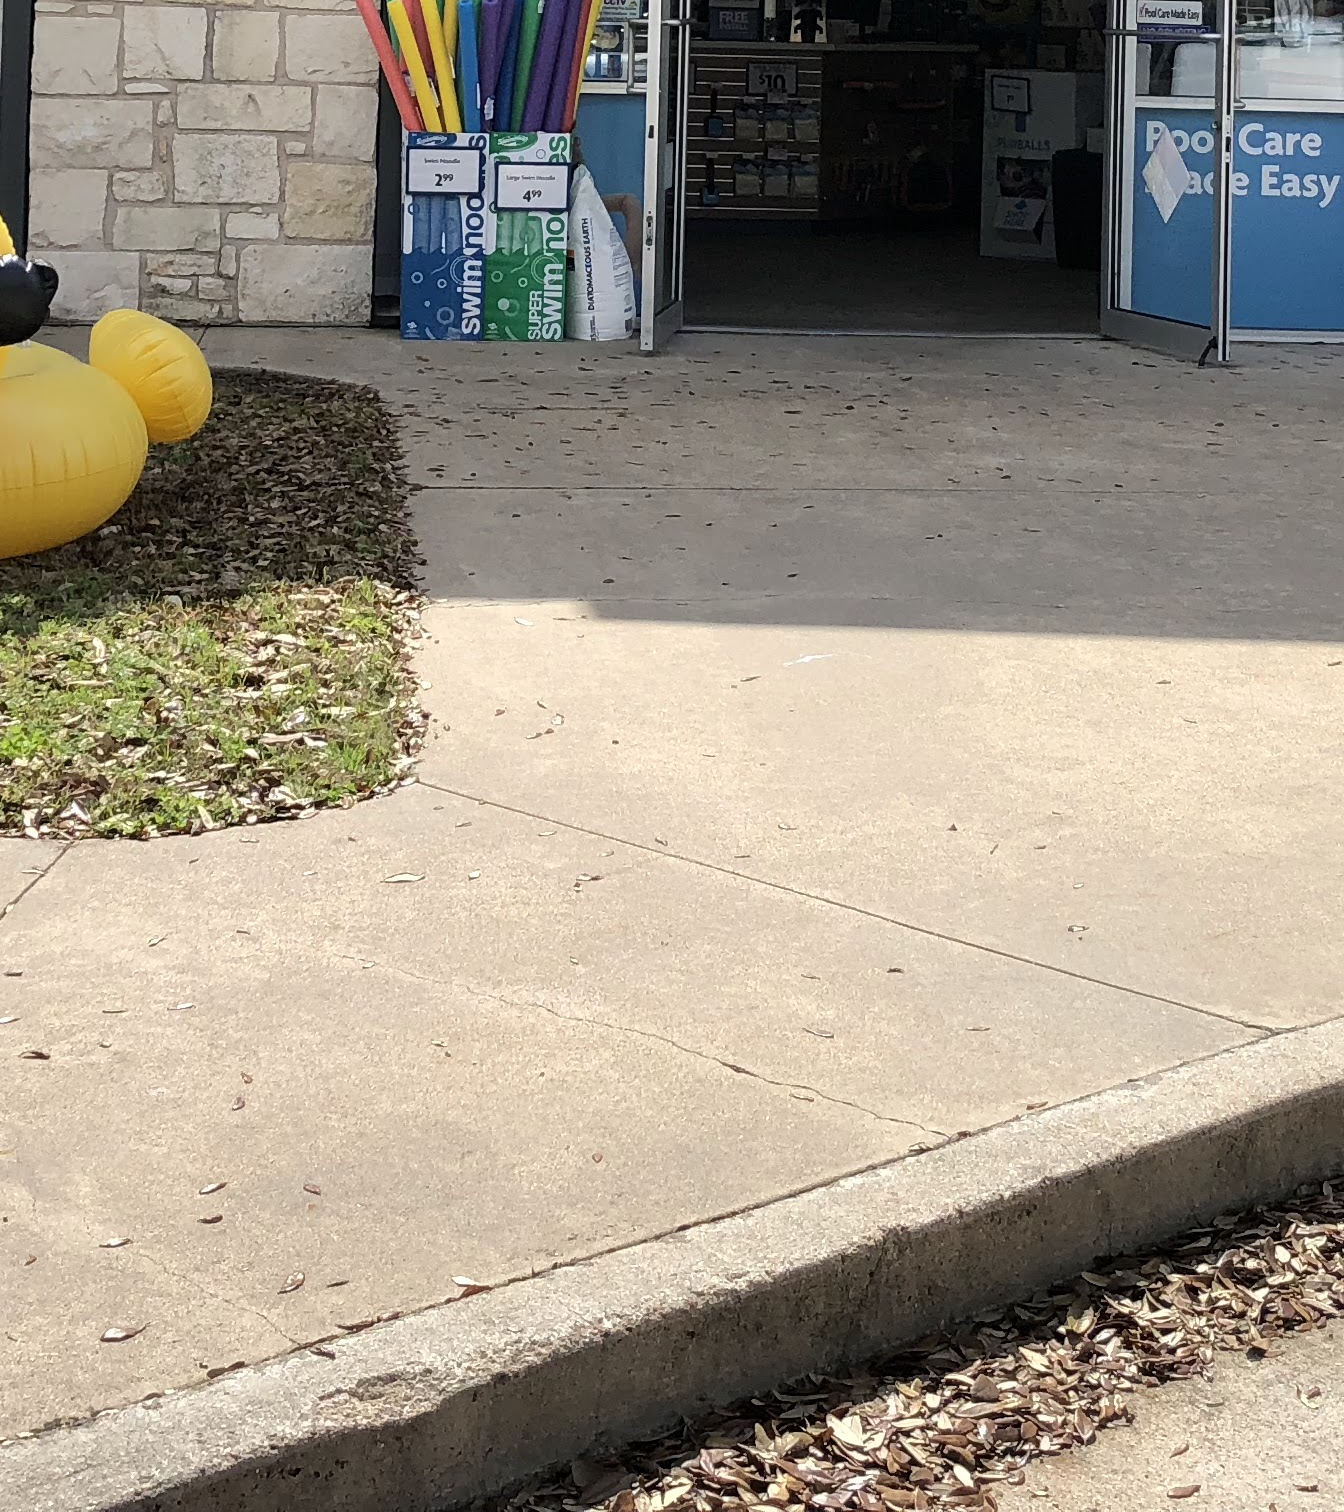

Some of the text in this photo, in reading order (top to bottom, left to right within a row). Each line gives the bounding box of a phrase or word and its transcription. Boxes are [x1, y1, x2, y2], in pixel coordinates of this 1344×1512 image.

[1145, 7, 1200, 22] Pool Care Made Easy
[1145, 120, 1322, 157] Poo Care
[1260, 164, 1341, 208] Easy
[581, 217, 592, 244] EARTH
[456, 259, 483, 335] swim
[582, 246, 595, 311] DIATOMACEOUS
[528, 290, 543, 340] SUPER
